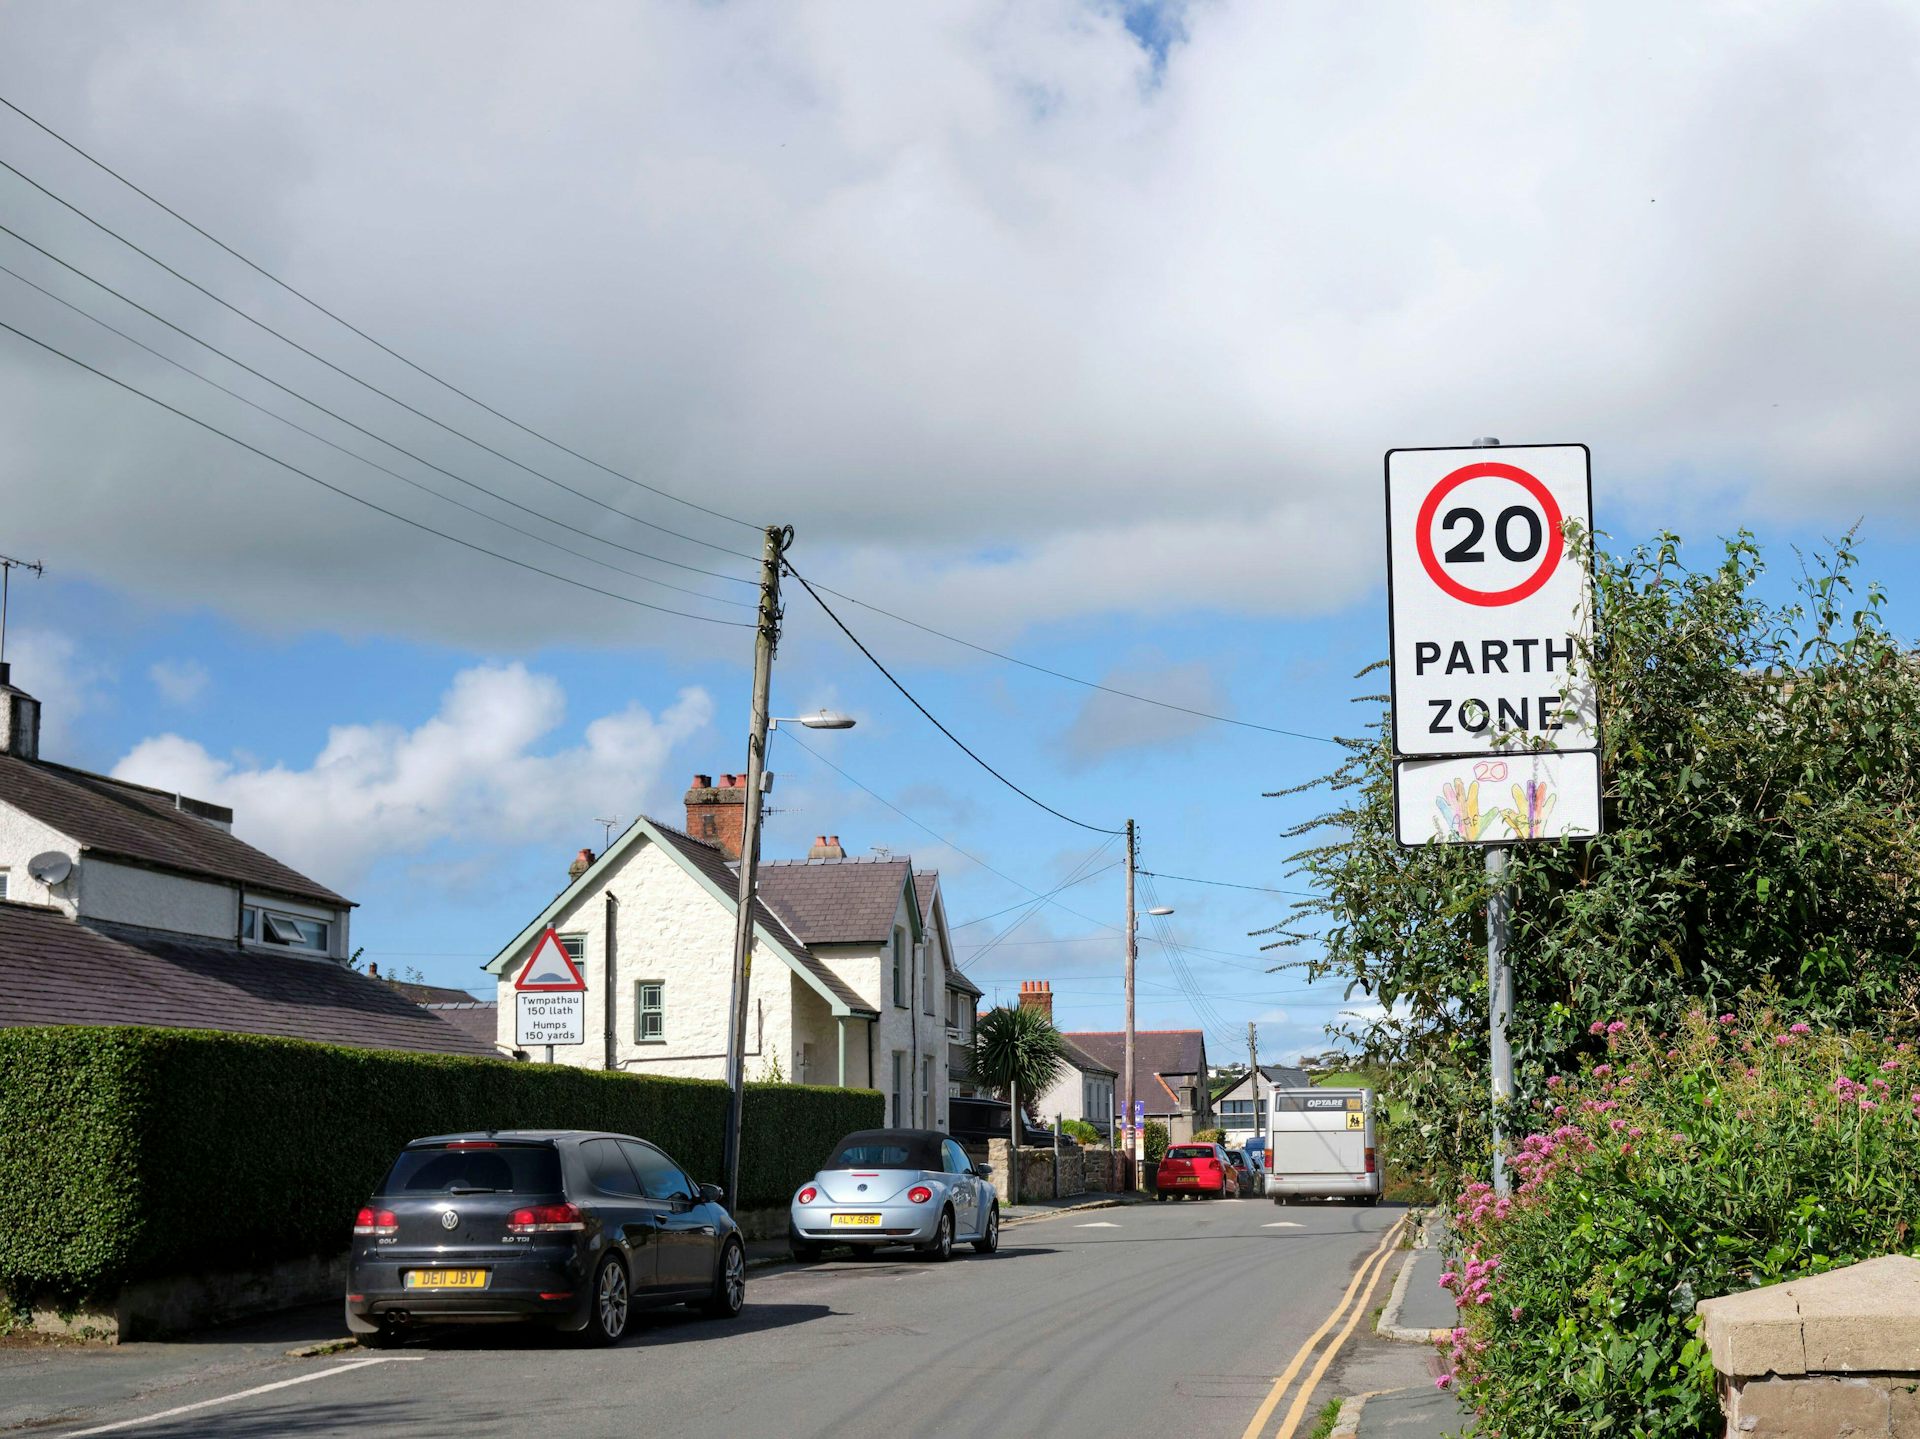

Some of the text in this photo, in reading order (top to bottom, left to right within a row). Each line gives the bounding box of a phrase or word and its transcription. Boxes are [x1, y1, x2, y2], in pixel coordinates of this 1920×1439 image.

[1442, 505, 1542, 563] 20
[1416, 638, 1573, 676] PARTH
[1429, 696, 1564, 734] ZONE
[1473, 762, 1506, 782] 20
[522, 996, 579, 1005] Twmpathau
[527, 1006, 573, 1015] 150 llath
[533, 1021, 567, 1030] Humps
[525, 1031, 575, 1041] 150 yards
[1307, 1099, 1343, 1107] OPTARE
[838, 1216, 855, 1224] ALY
[450, 1271, 477, 1285] JBV
